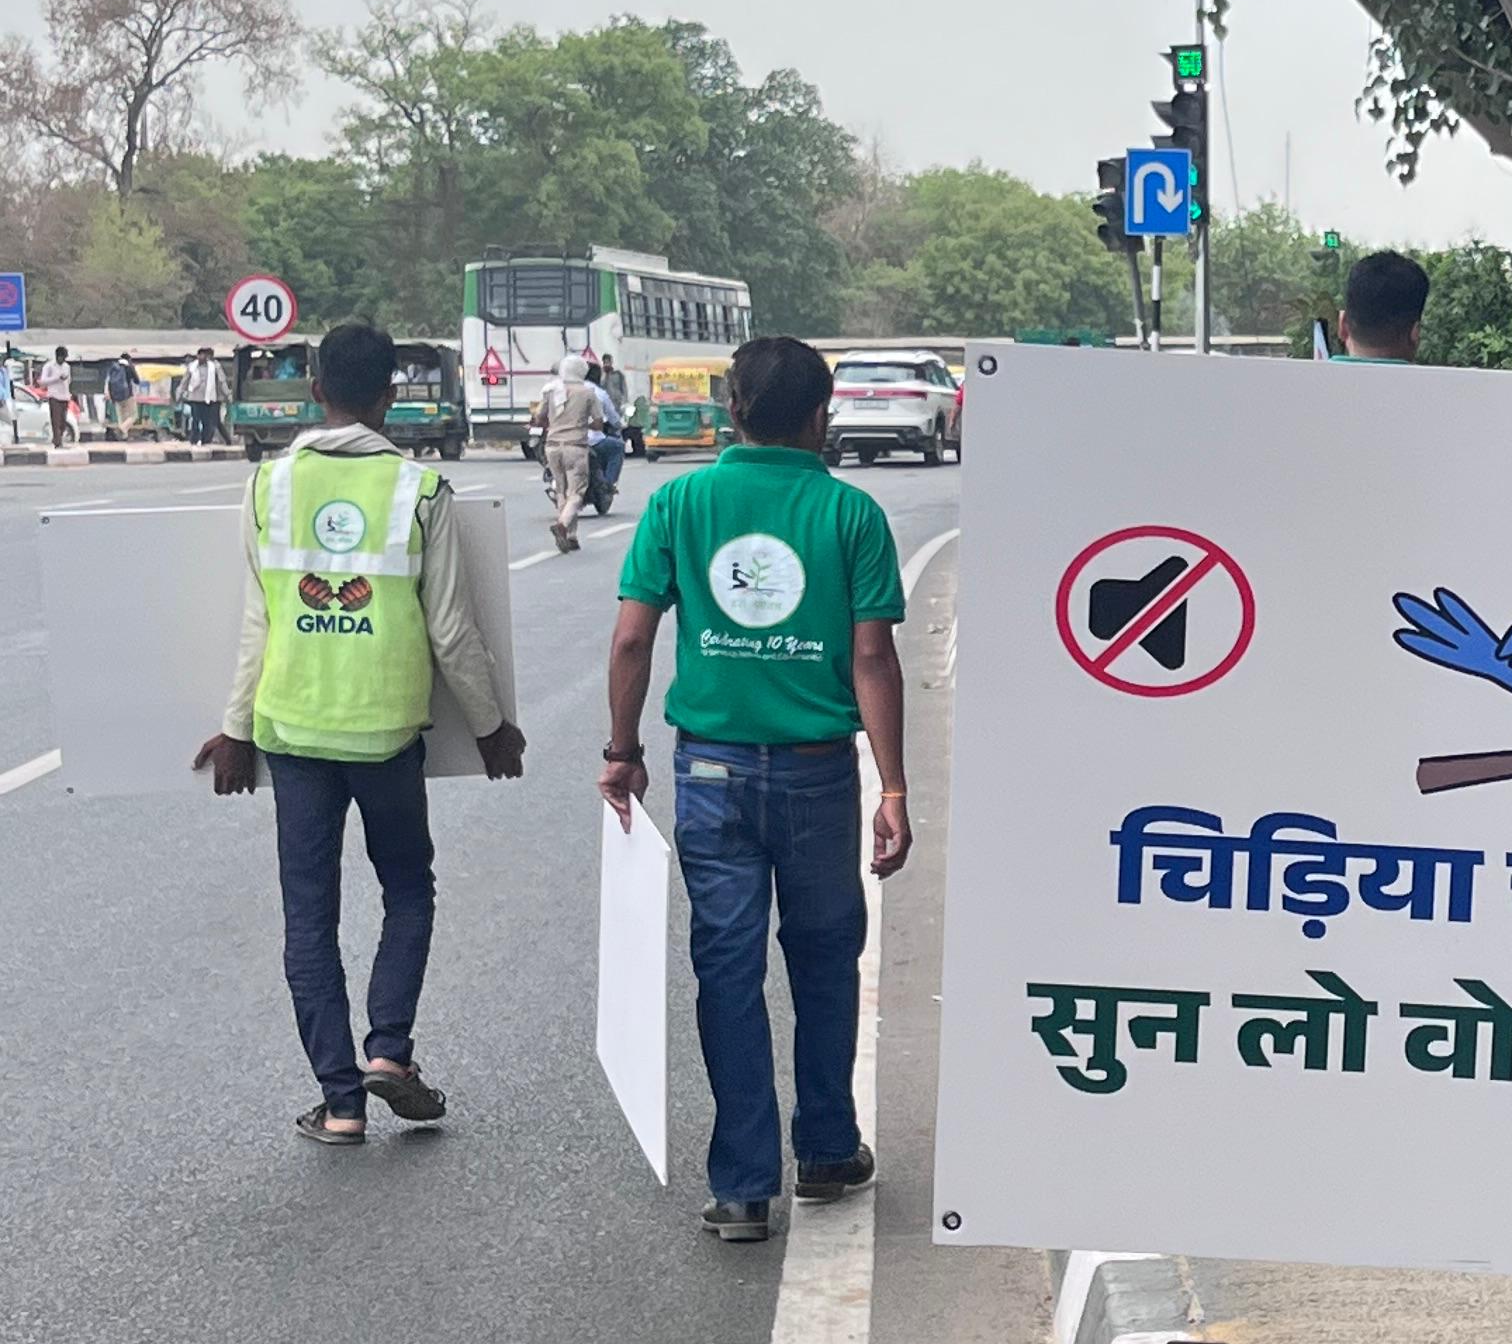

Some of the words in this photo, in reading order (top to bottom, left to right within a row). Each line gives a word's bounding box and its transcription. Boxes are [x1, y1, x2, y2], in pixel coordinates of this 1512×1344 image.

[240, 294, 283, 323] 40
[296, 614, 374, 635] GMDA
[766, 635, 783, 650] 10
[1109, 805, 1485, 939] चिड़िया
[1026, 982, 1211, 1095] सुन
[1231, 969, 1379, 1073] लो
